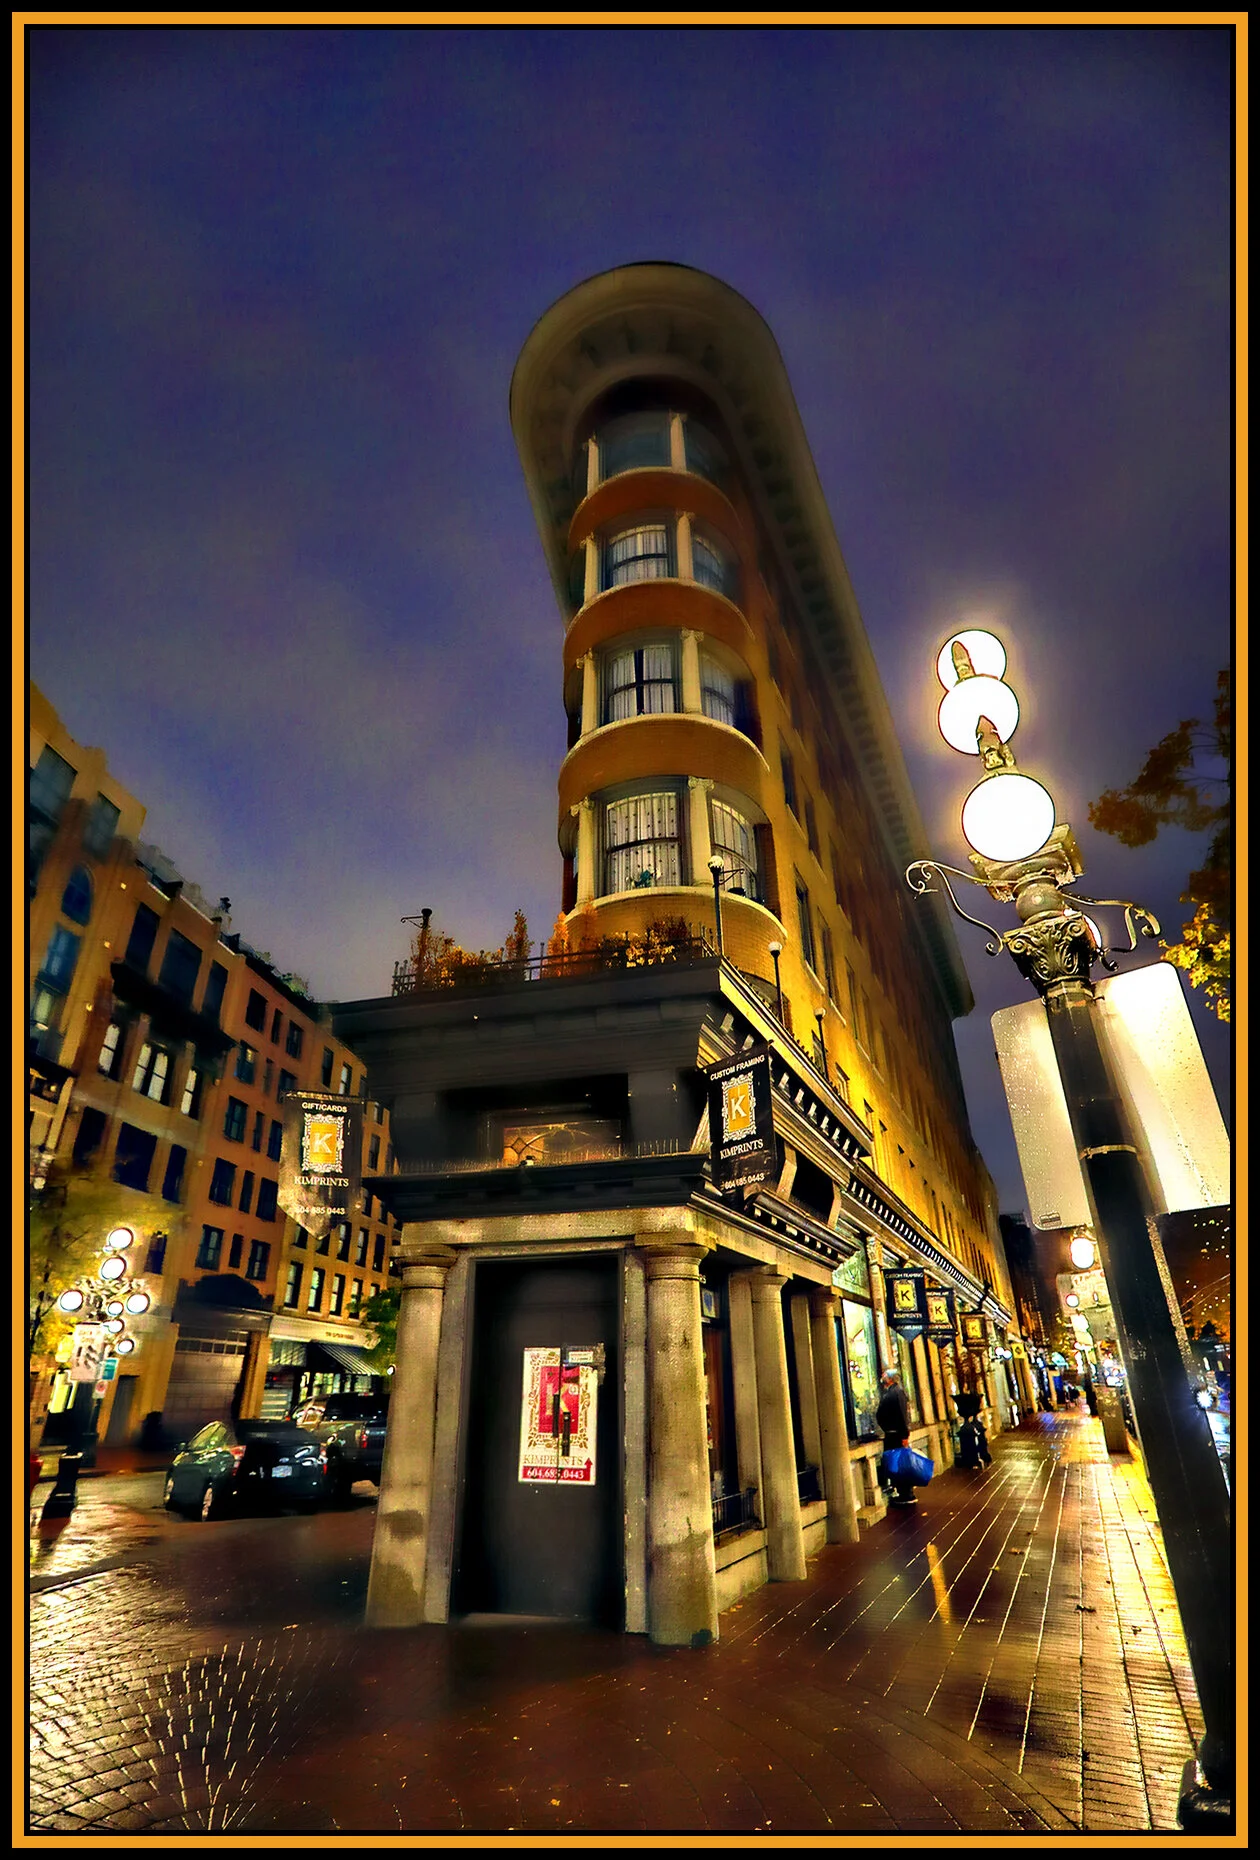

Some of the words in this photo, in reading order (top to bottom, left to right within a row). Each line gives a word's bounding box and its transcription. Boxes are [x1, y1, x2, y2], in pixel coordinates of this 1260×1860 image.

[710, 1065, 736, 1081] CUSTOM
[736, 1055, 765, 1071] FRAMING
[301, 1102, 348, 1113] GIFT/CARDS
[730, 1095, 747, 1121] K
[313, 1133, 333, 1154] K
[720, 1139, 764, 1160] KIMPRINTS
[294, 1176, 350, 1188] KIMPRINTS
[747, 1173, 765, 1184] 0443
[326, 1206, 346, 1215] 0443
[900, 1290, 911, 1302] K
[934, 1306, 943, 1316] K
[545, 1383, 570, 1416] K
[523, 1454, 584, 1466] KIMPRNTS
